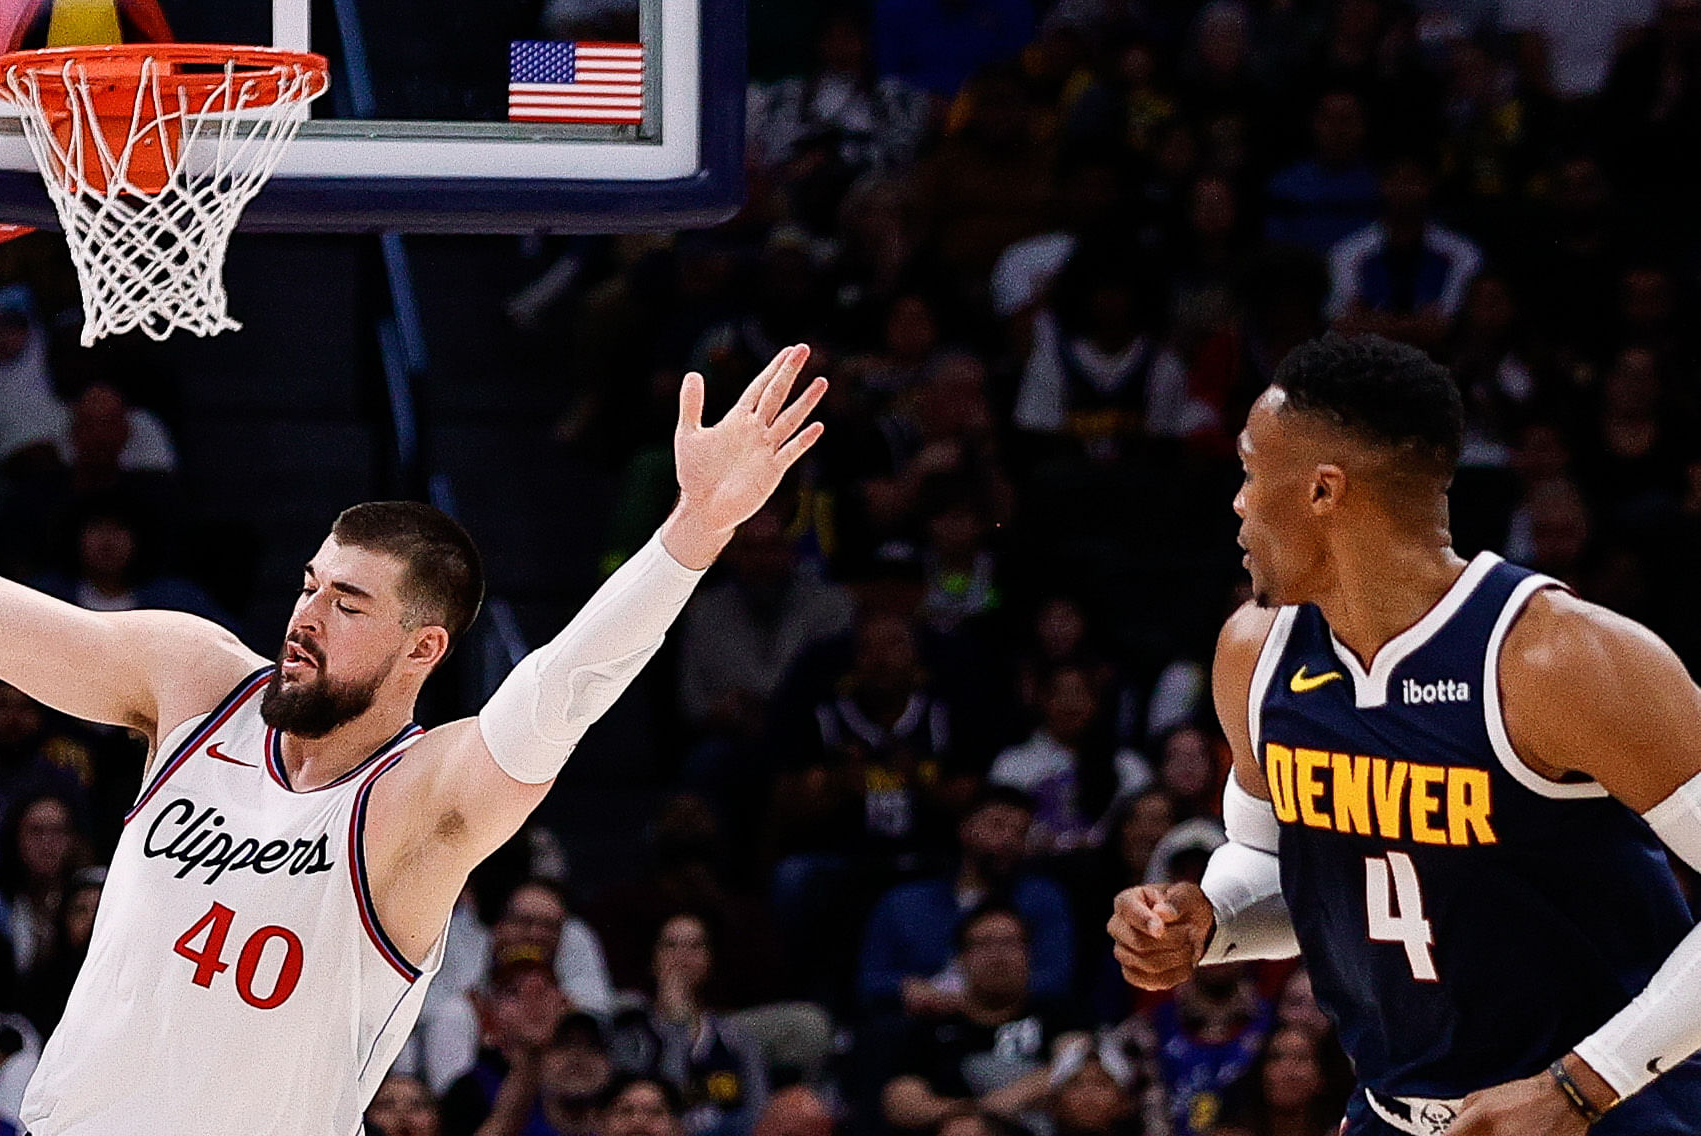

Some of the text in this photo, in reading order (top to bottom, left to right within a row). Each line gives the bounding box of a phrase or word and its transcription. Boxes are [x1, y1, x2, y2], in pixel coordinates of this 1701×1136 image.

[1402, 678, 1470, 705] ibotta
[144, 799, 334, 885] Clippers
[1265, 741, 1499, 847] DENVER
[173, 901, 303, 1009] 40
[1364, 850, 1440, 983] 4
